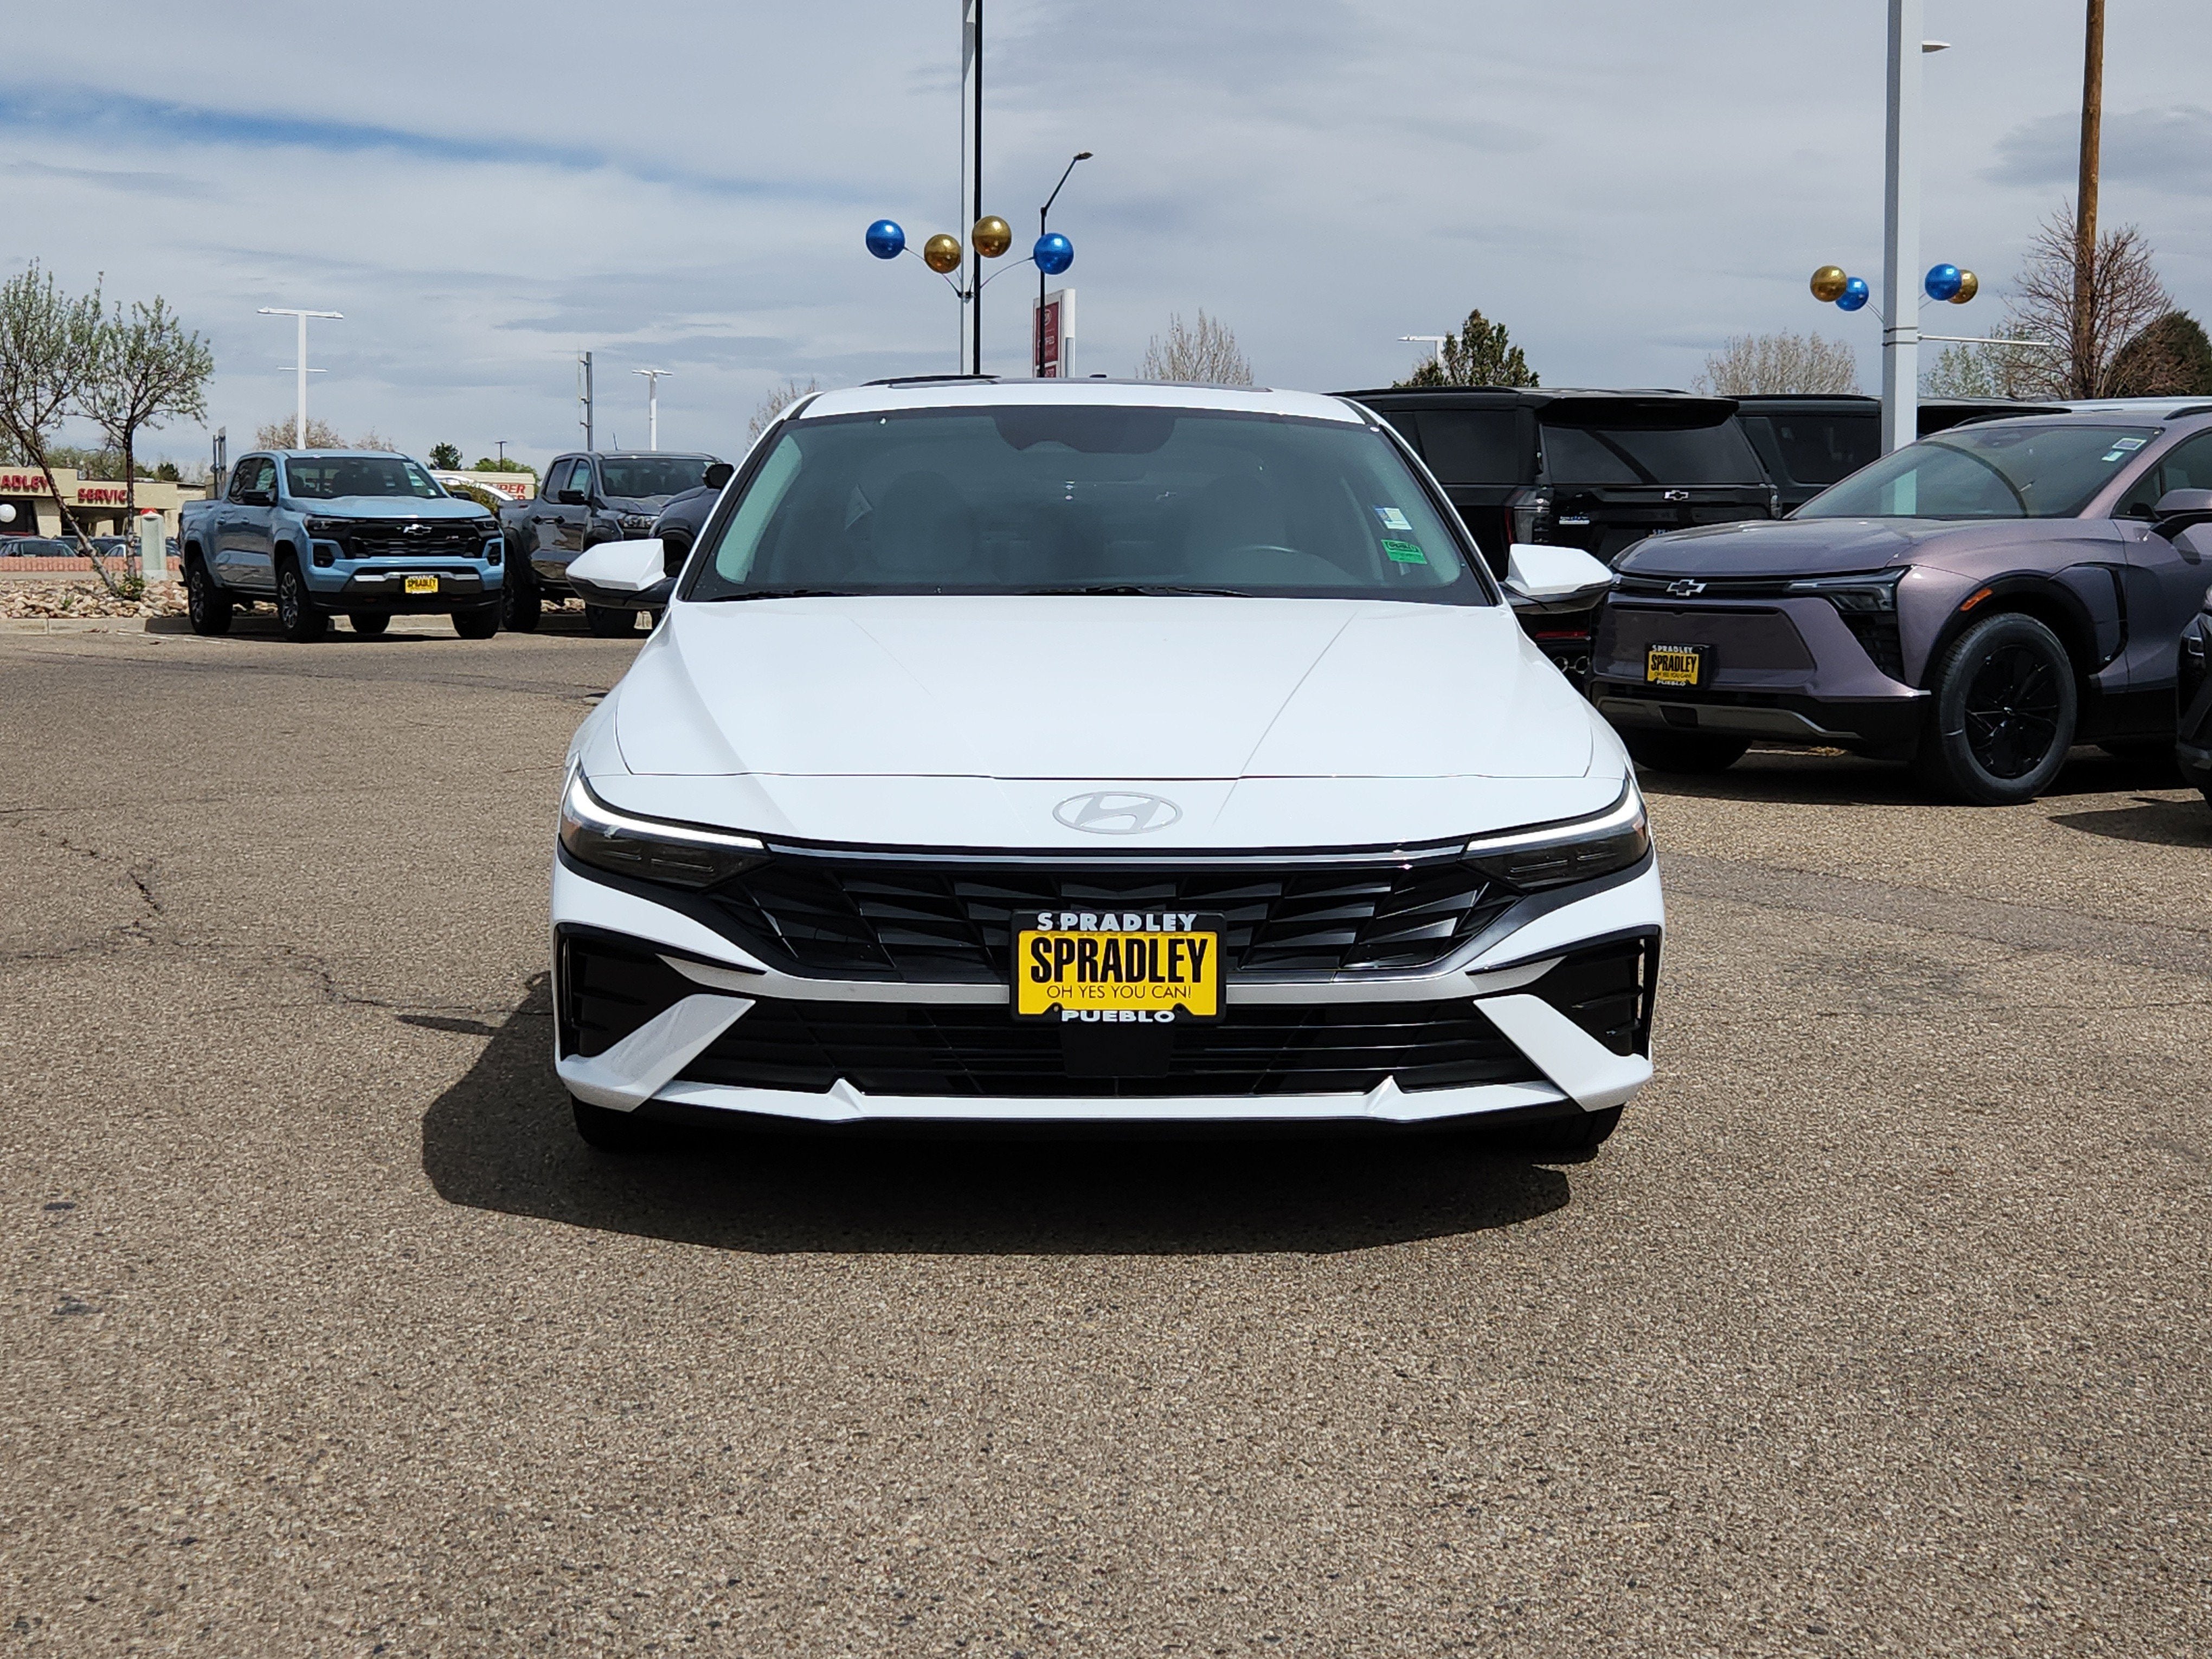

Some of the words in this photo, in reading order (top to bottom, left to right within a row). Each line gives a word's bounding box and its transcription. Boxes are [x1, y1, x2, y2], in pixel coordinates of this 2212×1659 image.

[0, 475, 48, 488] ADLEY
[78, 488, 128, 501] SERVIC
[1652, 645, 1693, 653] SPRADLEY
[1651, 654, 1696, 673] SPRADLEY
[1037, 912, 1197, 931] SPRADLEY
[1031, 937, 1208, 983] SPRADLEY
[1047, 985, 1072, 999] OH
[1078, 985, 1105, 999] YES
[1111, 985, 1146, 999] YOU
[1152, 985, 1191, 999] CAN!
[1062, 1010, 1175, 1022] PUEBLO
